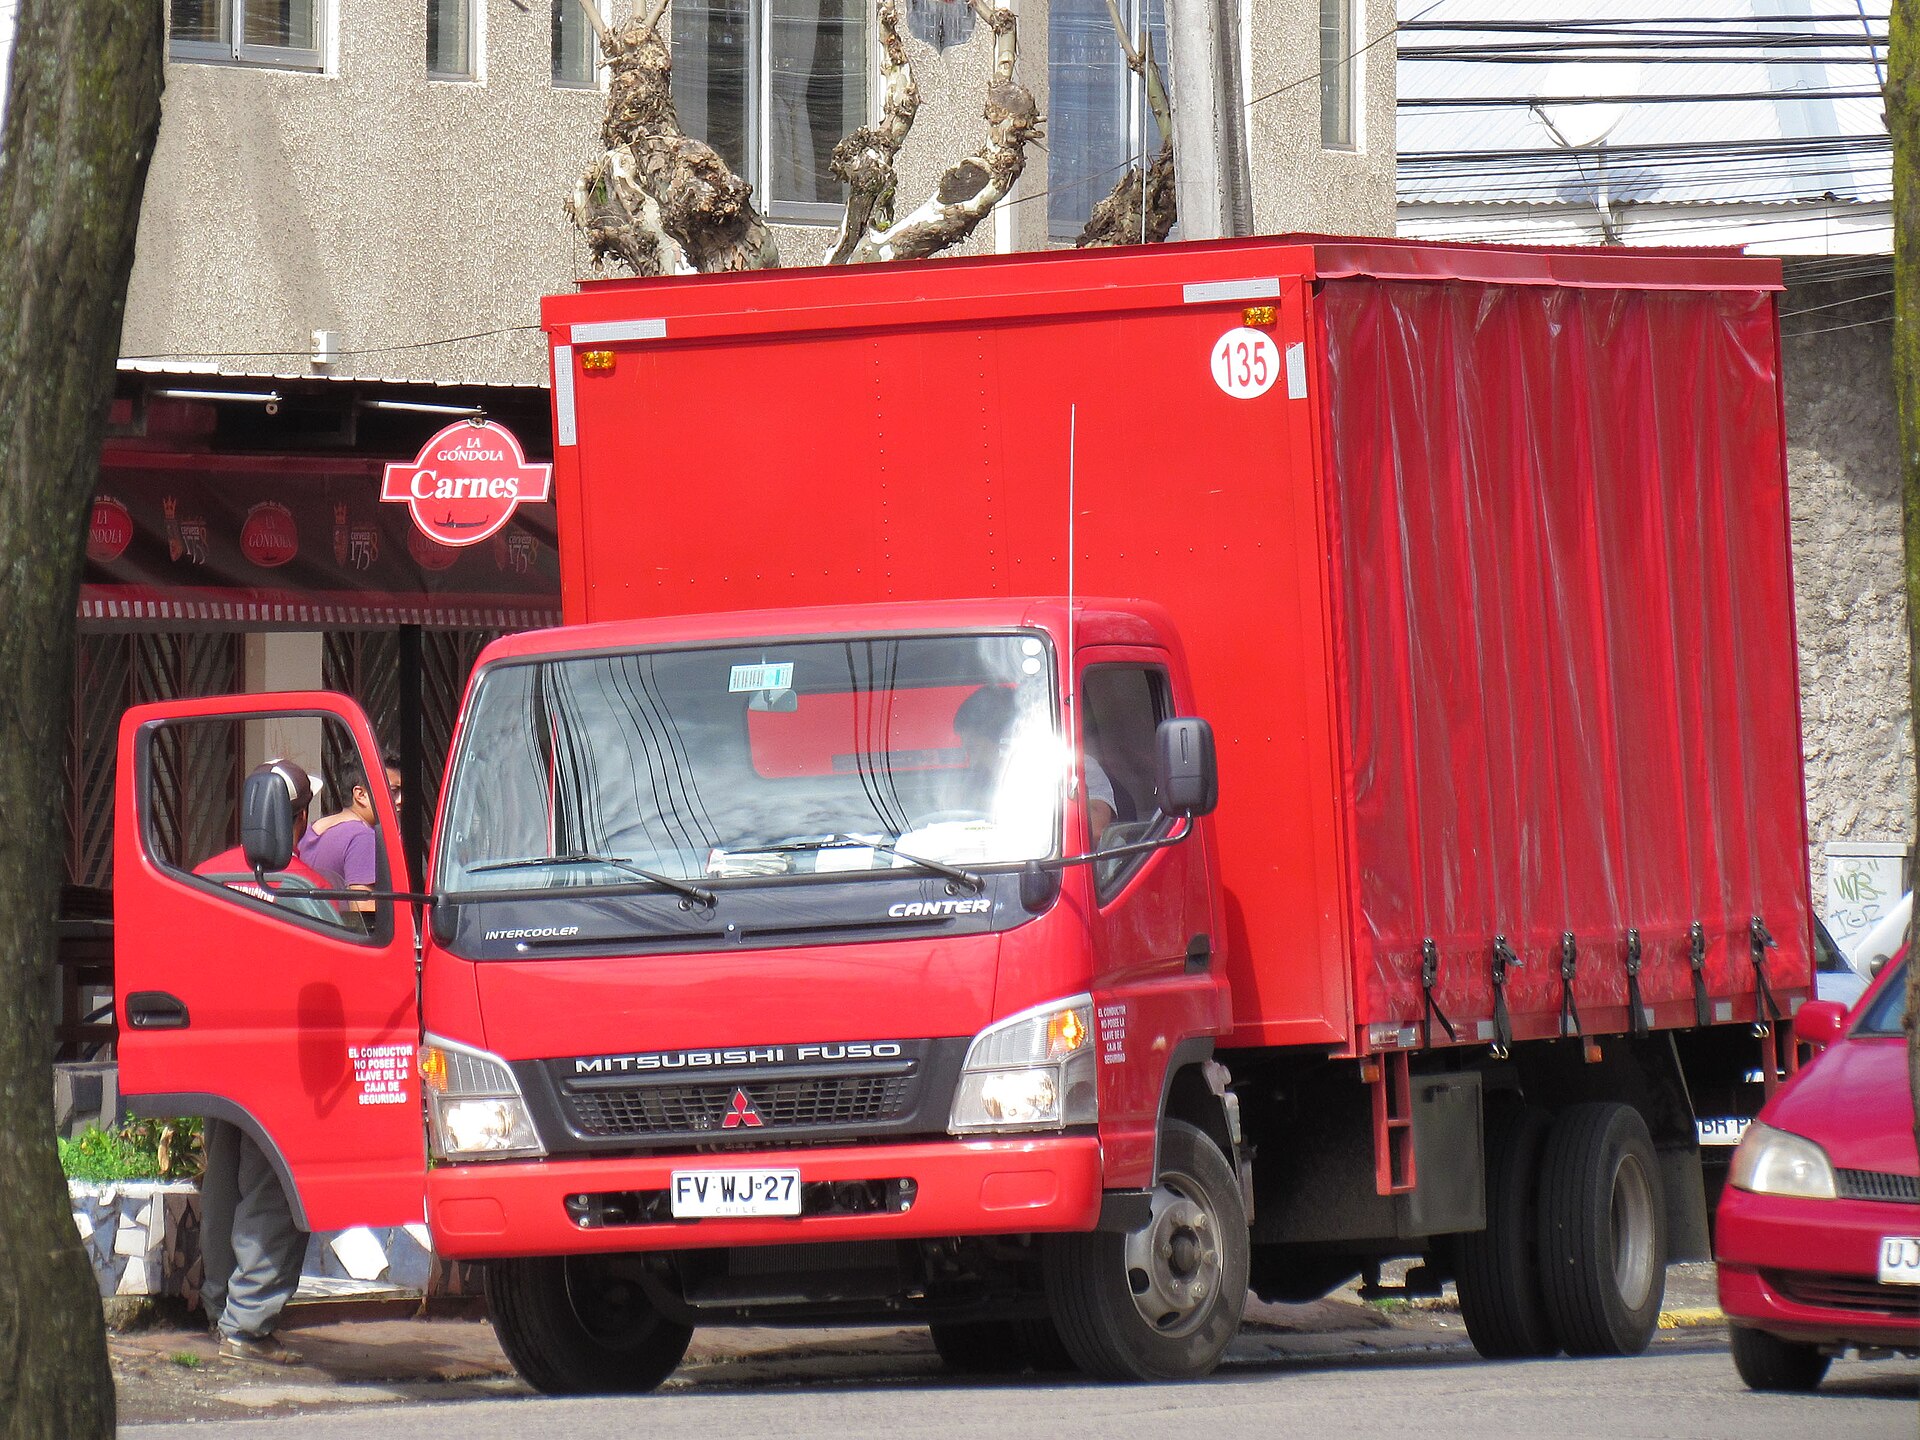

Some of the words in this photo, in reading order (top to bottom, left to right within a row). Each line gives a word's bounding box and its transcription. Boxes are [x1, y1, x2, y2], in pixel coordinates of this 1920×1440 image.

[1221, 341, 1267, 387] 135
[466, 437, 481, 449] LA
[437, 445, 503, 461] GÓNDOLA
[410, 469, 519, 499] Carnes
[888, 899, 991, 918] CANTER
[485, 926, 579, 940] INTERCOOLER
[1098, 1007, 1104, 1018] EL
[1101, 1020, 1107, 1029] NO
[1120, 1017, 1125, 1027] LA
[1115, 1030, 1119, 1039] DE
[1120, 1029, 1125, 1039] LA
[348, 1048, 359, 1058] EL
[361, 1046, 412, 1057] CONDUCTOR
[1117, 1041, 1122, 1051] DE
[354, 1060, 366, 1069] NO
[368, 1058, 395, 1069] POSEE
[397, 1058, 408, 1068] LA
[575, 1049, 784, 1073] MITSUBISHI
[798, 1044, 900, 1061] FUSO
[355, 1071, 382, 1082] LLAVE
[383, 1070, 394, 1080] DE
[396, 1069, 408, 1079] LA
[364, 1082, 386, 1092] CAJA
[388, 1081, 399, 1091] DE
[359, 1093, 407, 1104] SEGURIDAD
[715, 1206, 758, 1214] CHILE
